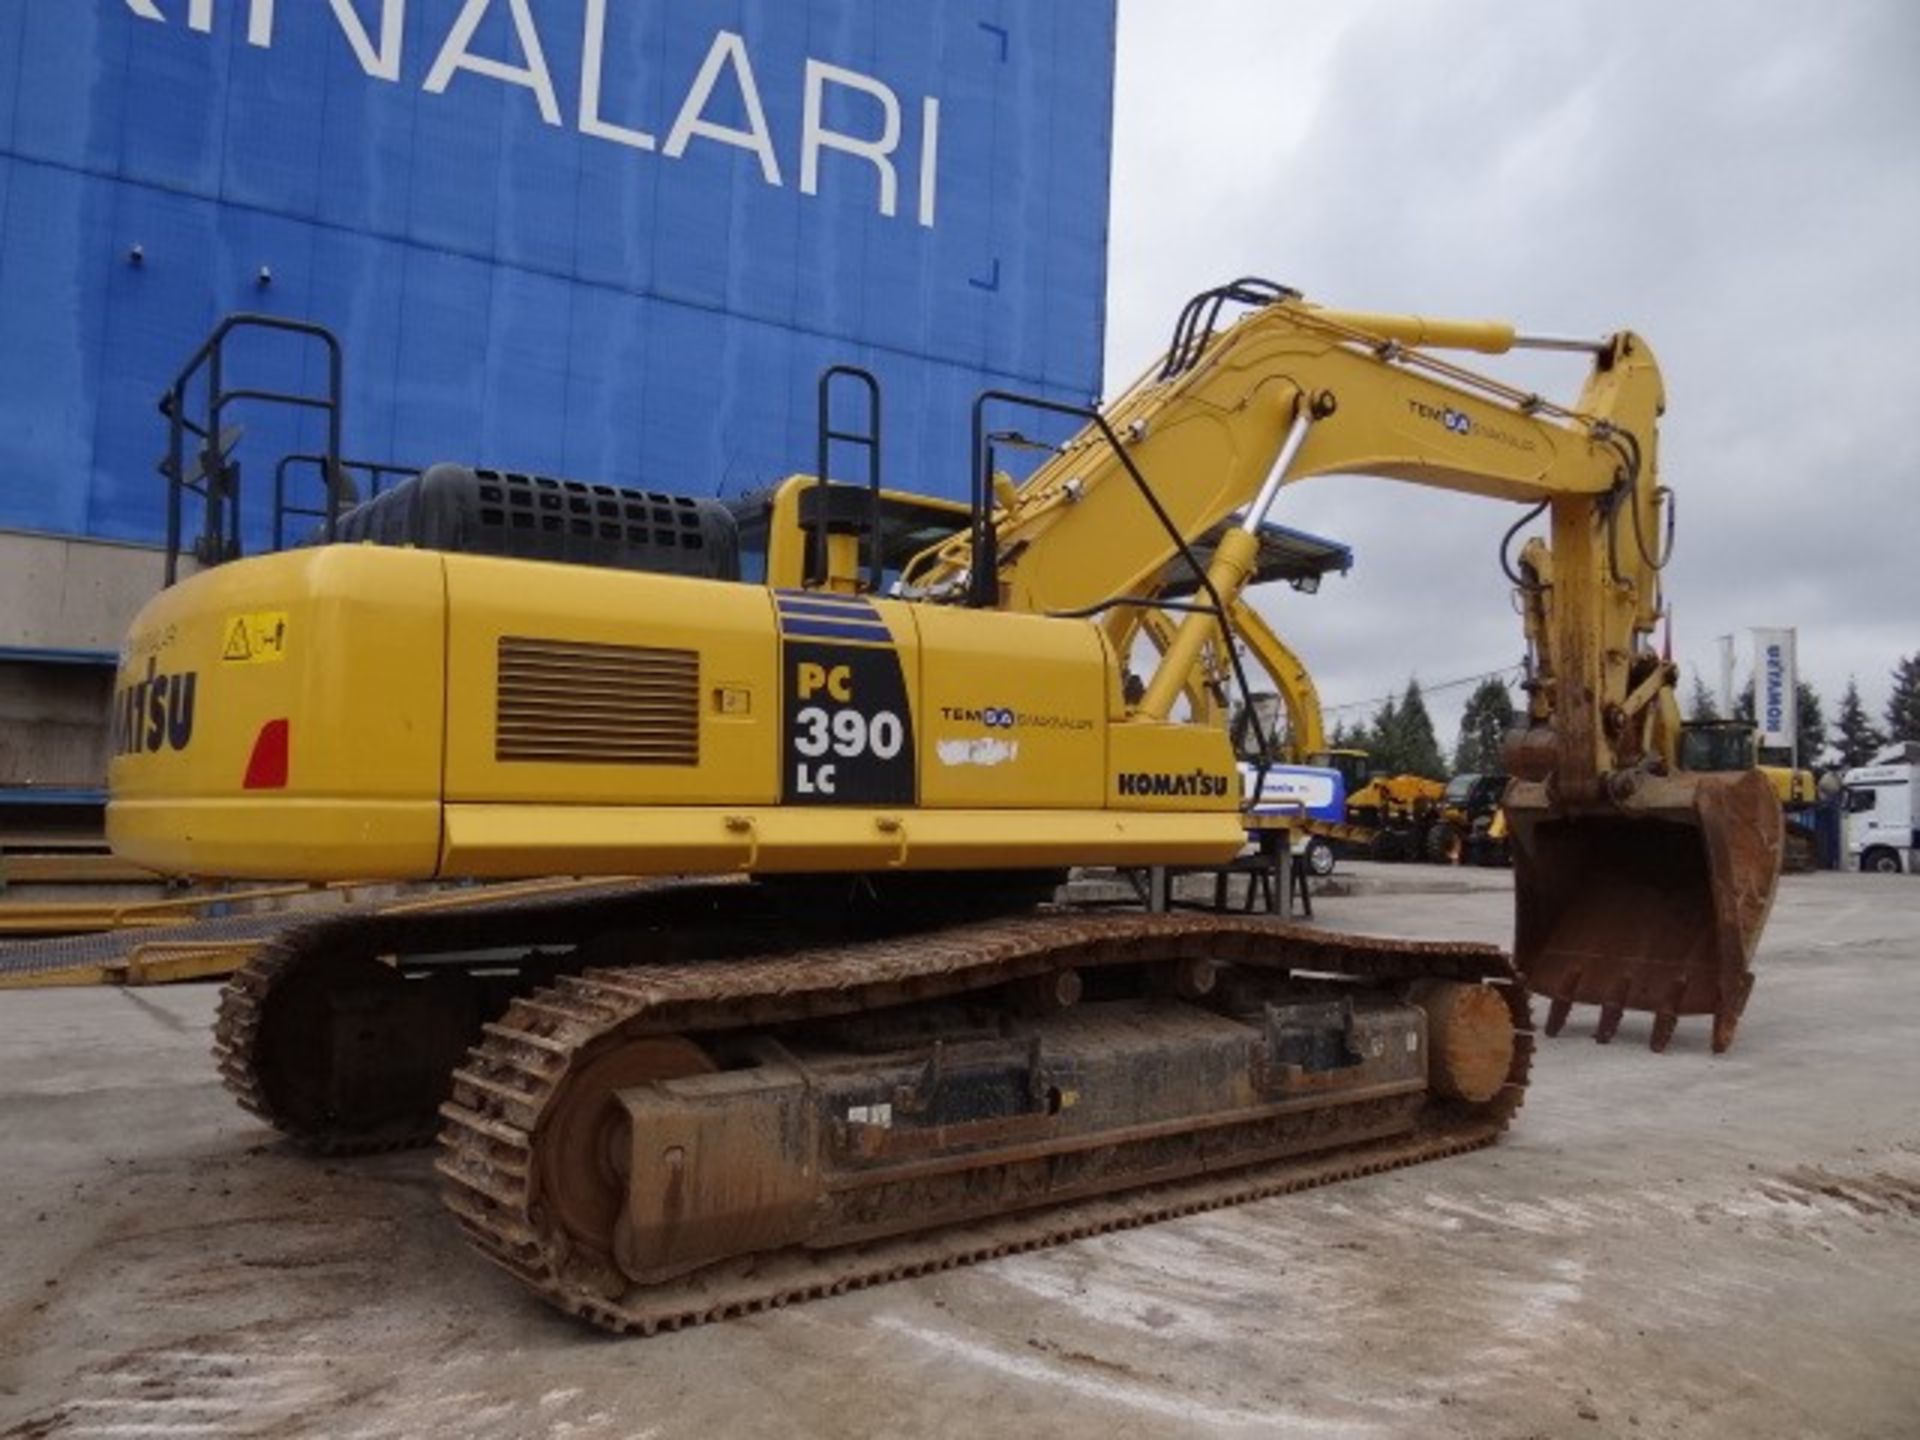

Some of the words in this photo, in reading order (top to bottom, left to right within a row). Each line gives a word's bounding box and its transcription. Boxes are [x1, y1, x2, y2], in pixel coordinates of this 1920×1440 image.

[125, 0, 939, 228] ALARI
[797, 662, 852, 702] PC
[794, 706, 905, 760] 390
[796, 764, 836, 795] LC
[1118, 768, 1228, 797] KOMATSU
